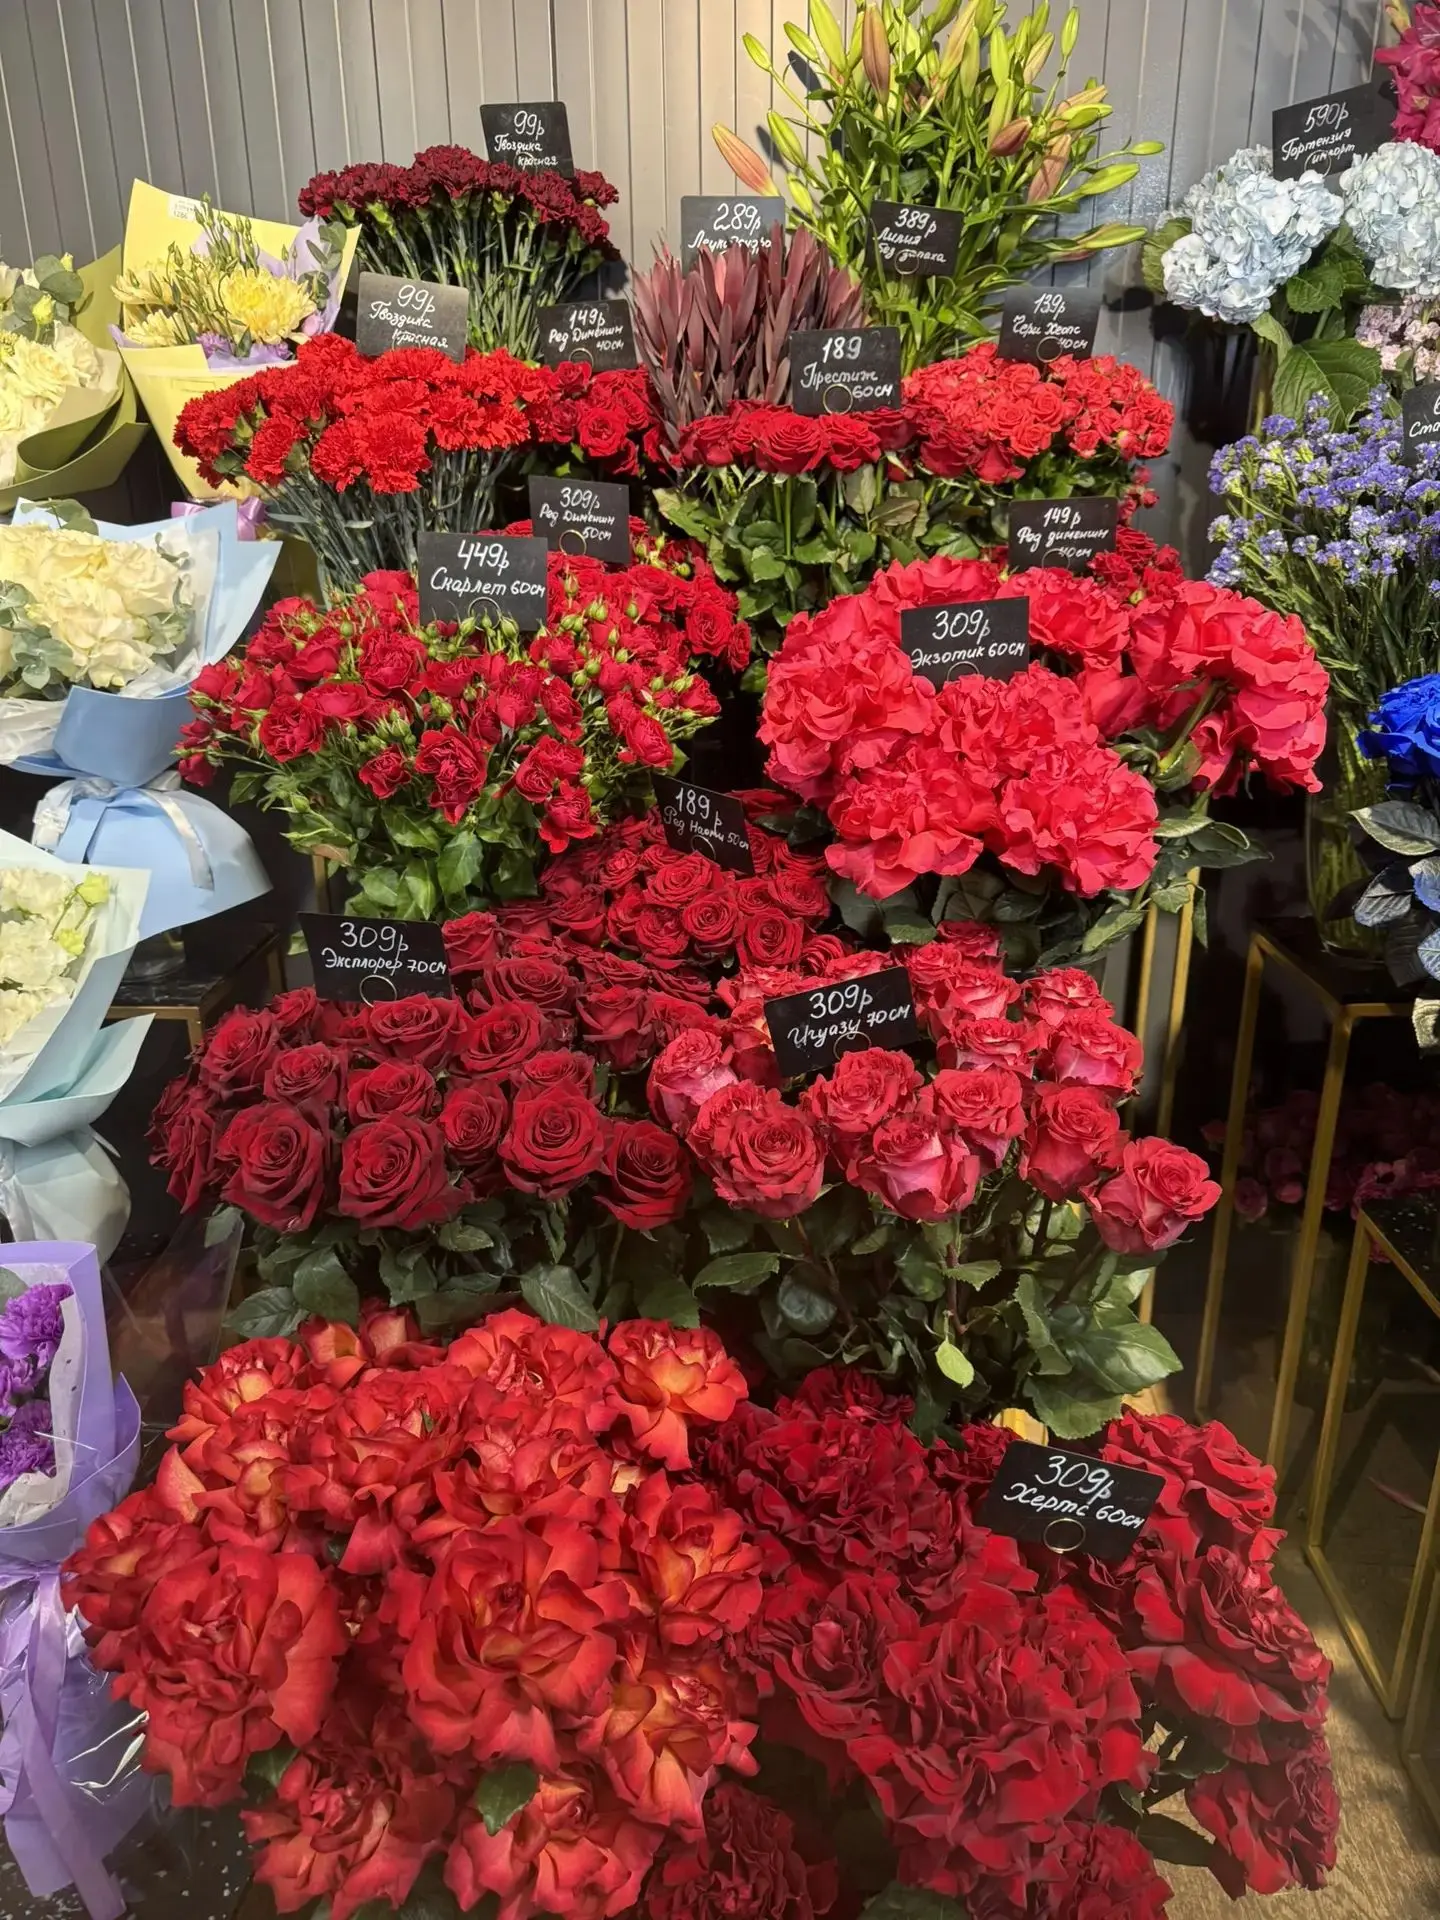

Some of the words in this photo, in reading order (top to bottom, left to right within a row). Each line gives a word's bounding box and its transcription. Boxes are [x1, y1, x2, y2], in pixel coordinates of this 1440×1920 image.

[513, 110, 545, 140] 99р
[1304, 102, 1349, 133] 590р
[494, 133, 543, 155] Гвоздика
[1281, 128, 1352, 161] Гортензия
[713, 203, 761, 236] 289р
[872, 227, 922, 245] Лилия
[369, 301, 433, 328] Гвоздика
[397, 284, 436, 319] 99р
[1033, 293, 1066, 321] 139р
[569, 308, 606, 331] 149р
[1012, 314, 1042, 338] Чери
[548, 328, 569, 352] Ред
[596, 339, 624, 351] 40см
[822, 336, 862, 363] 189
[800, 361, 878, 391] Престиж
[852, 384, 894, 399] 60см
[560, 487, 600, 515] 309р
[1043, 506, 1081, 530] 149р
[582, 526, 612, 541] 50см
[457, 539, 510, 577] 449р
[430, 566, 507, 598] Скарлет
[510, 580, 546, 598] 60см
[932, 609, 991, 645] 309р
[911, 646, 985, 669] Экзотик
[988, 642, 1026, 658] 60см
[340, 921, 409, 960] 309р
[321, 947, 403, 976] Эксплорер
[407, 959, 447, 975] 70см
[809, 984, 874, 1019] 309р
[787, 1018, 861, 1048] Игуазу
[867, 1004, 911, 1028] 70см
[1034, 1455, 1114, 1505] 309р
[1003, 1482, 1090, 1517] Хертс
[1095, 1505, 1145, 1529] 60см
